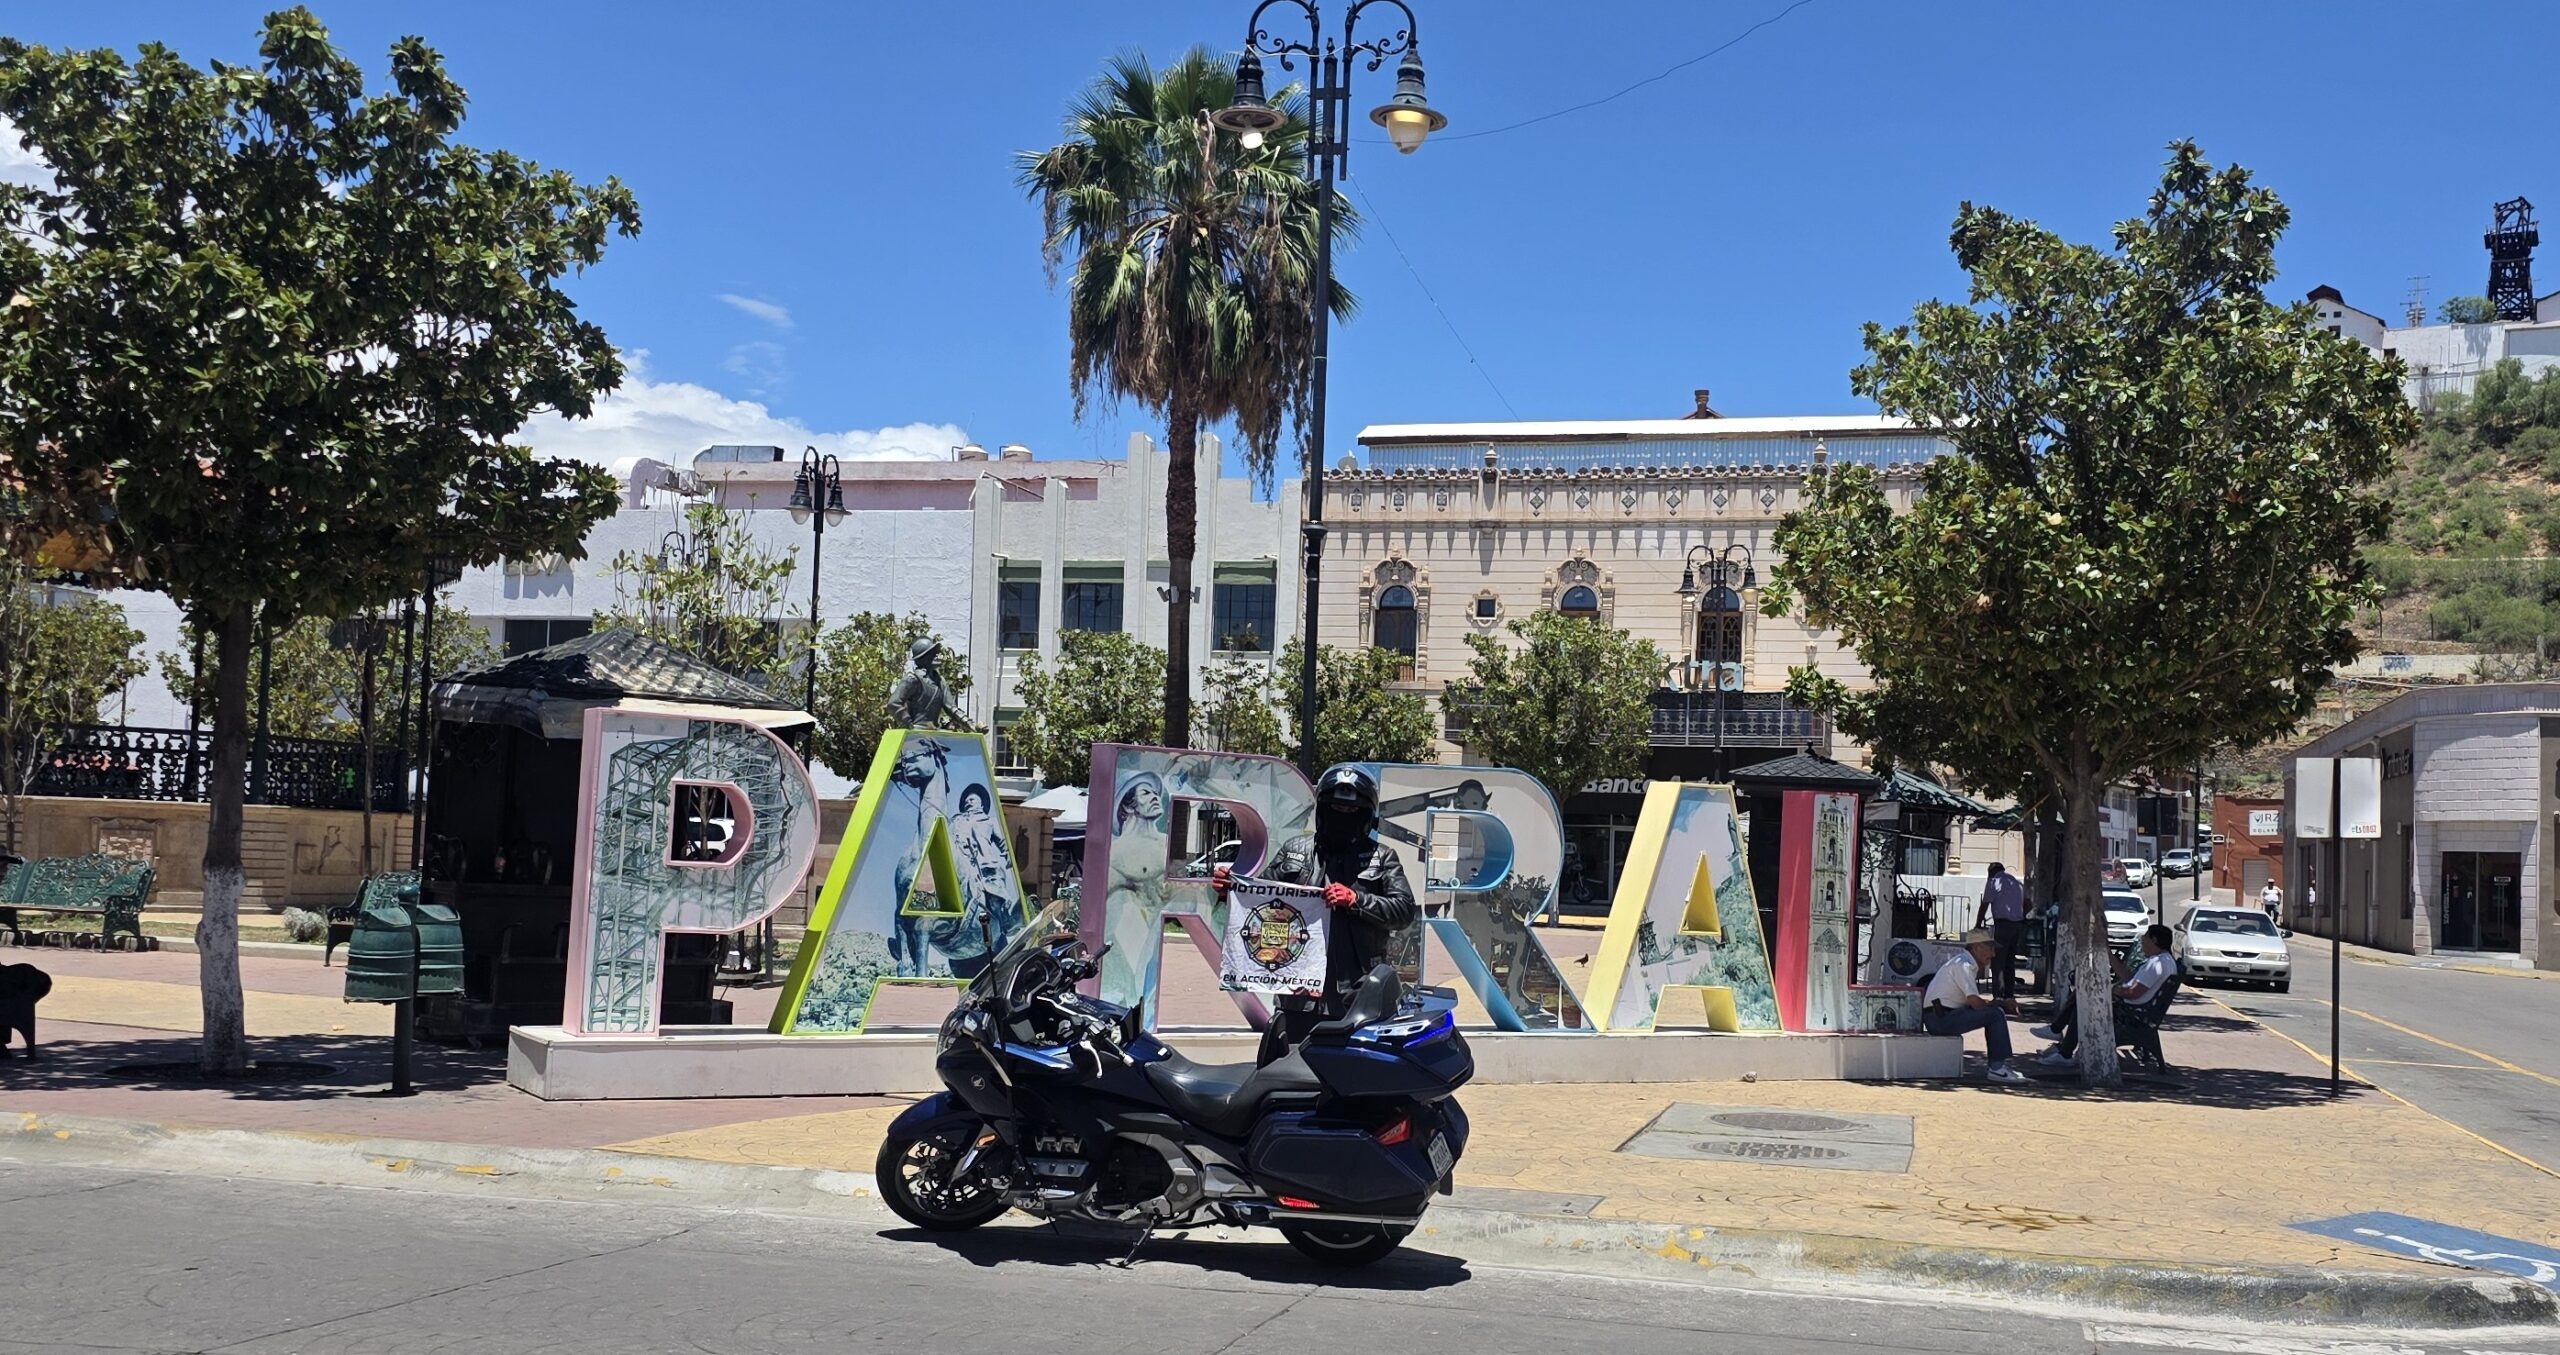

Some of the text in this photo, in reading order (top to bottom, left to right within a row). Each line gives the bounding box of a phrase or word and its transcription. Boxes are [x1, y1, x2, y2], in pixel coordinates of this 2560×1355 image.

[562, 706, 1924, 1037] PARRAL
[1229, 883, 1323, 898] MOTOTURISM
[1223, 973, 1321, 988] EN ACCIÓN MÉXICO
